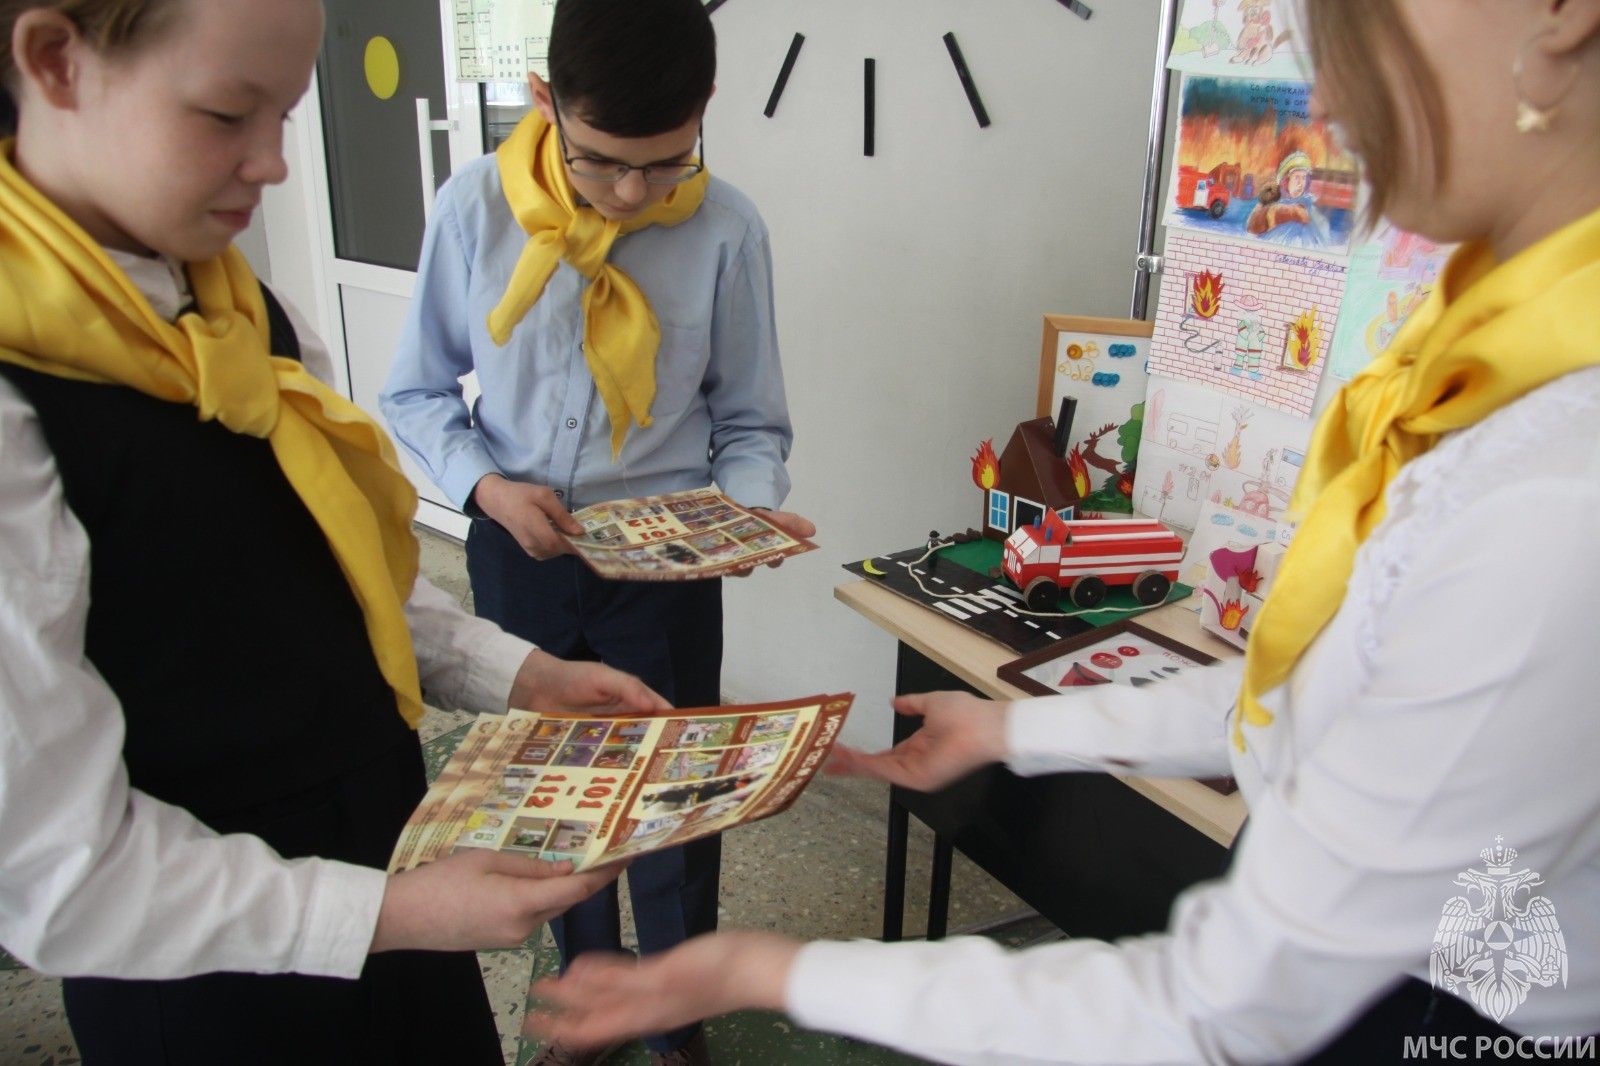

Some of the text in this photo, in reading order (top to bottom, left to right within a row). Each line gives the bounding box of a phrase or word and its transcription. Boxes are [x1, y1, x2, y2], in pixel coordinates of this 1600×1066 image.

[638, 527, 678, 541] 101
[523, 775, 567, 809] 112
[575, 776, 618, 809] 101
